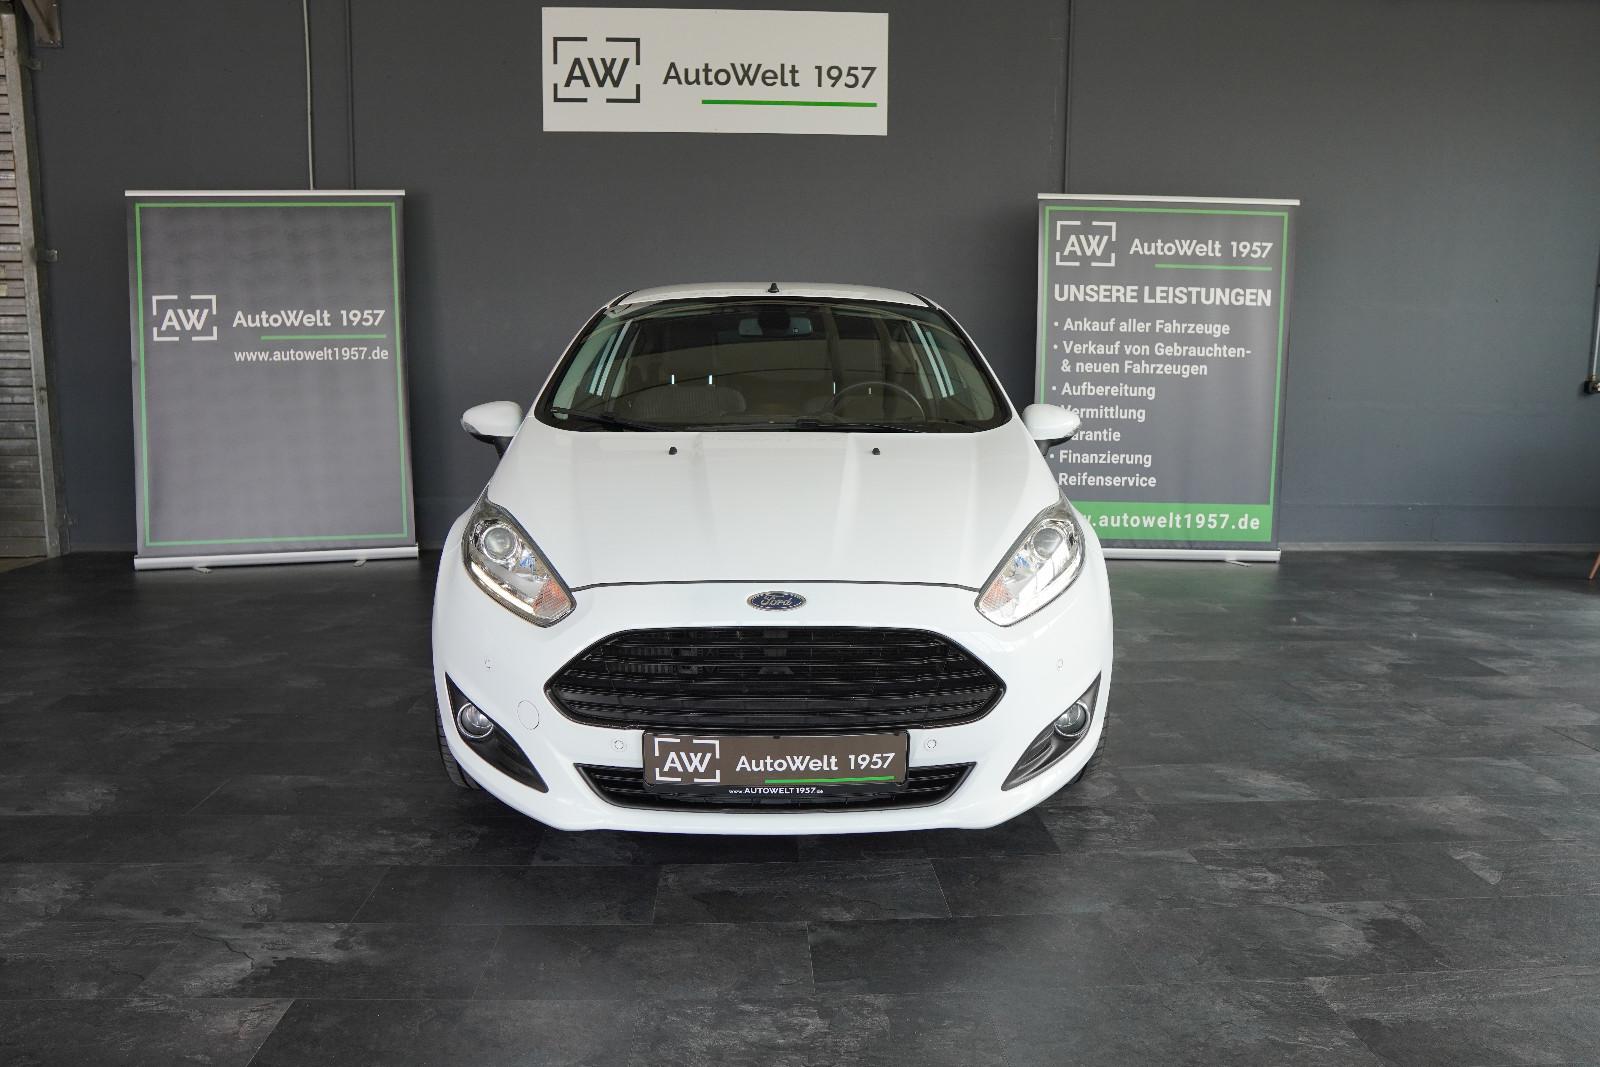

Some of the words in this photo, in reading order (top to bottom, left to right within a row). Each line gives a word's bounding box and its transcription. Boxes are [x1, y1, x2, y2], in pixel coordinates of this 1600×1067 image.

[563, 57, 630, 88] AW
[662, 62, 800, 87] AutoWelt
[814, 65, 877, 89] 1957
[1063, 234, 1109, 256] AW
[1129, 238, 1222, 257] AutoWelt
[1230, 241, 1273, 258] 1957
[1054, 283, 1138, 303] UNSERE
[1143, 286, 1272, 307] LEISTUNGEN
[161, 308, 209, 331] AW
[232, 310, 331, 328] AutoWelt
[340, 309, 386, 327] 1957
[1063, 318, 1116, 332] Ankauf
[1119, 319, 1151, 333] aller
[1155, 320, 1230, 338] Fahrzeuge
[233, 346, 389, 362] www.autowelt1957.de
[1063, 341, 1121, 354] Verkauf
[1124, 345, 1150, 355] von
[1154, 343, 1252, 358] Gebrauchten-
[1060, 359, 1072, 373] &
[1075, 362, 1120, 374] neuen
[1124, 360, 1208, 377] Fahrzeugen
[1061, 382, 1156, 400] Aufbereitung
[1071, 428, 1121, 442] arantie
[1059, 450, 1152, 467] Finanzierung
[1058, 472, 1157, 487] Reifenservice
[1083, 512, 1260, 529] .autowelt1957.de
[760, 594, 793, 606] Ford
[663, 752, 712, 773] AW
[735, 754, 838, 772] AutoWelt
[848, 752, 896, 771] 1957
